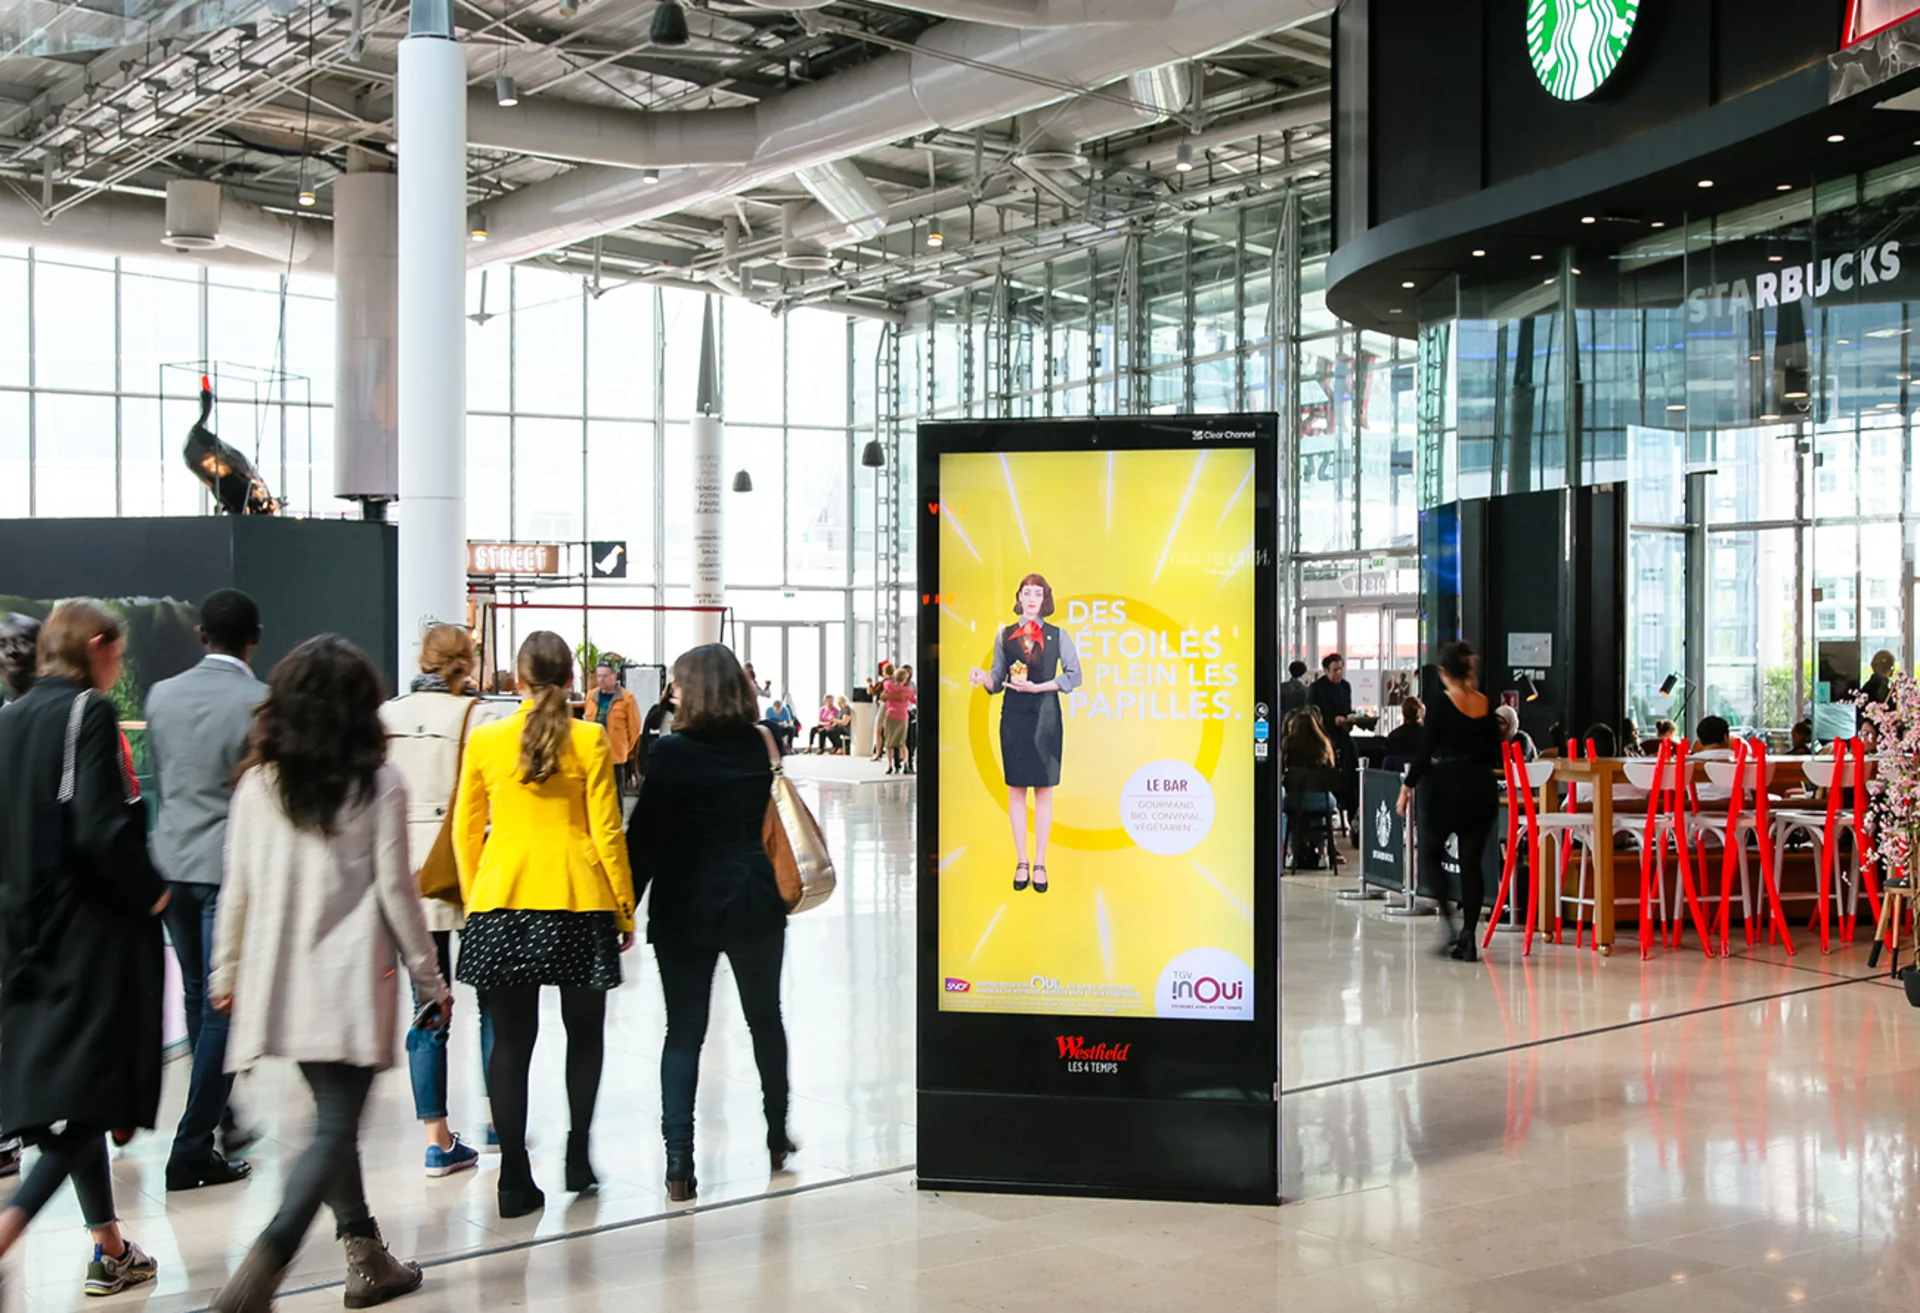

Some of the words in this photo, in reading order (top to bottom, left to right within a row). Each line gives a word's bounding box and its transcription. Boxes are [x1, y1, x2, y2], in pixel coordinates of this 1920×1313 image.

[1688, 240, 1901, 324] STARBUCKS
[1204, 430, 1223, 440] Clear
[1224, 430, 1256, 440] Channel
[475, 545, 547, 572] STREET
[1068, 600, 1127, 625] DES
[1075, 624, 1222, 660] ÉTOILES
[1096, 663, 1176, 687] PLEIN
[1188, 663, 1239, 687] LES
[1068, 691, 1243, 720] PAPILLES.
[1146, 779, 1160, 792] LE
[1163, 779, 1188, 792] BAR
[946, 981, 969, 992] SNCF
[1173, 971, 1193, 980] TGV
[1055, 1035, 1131, 1061] Westfield
[1067, 1061, 1083, 1073] LES
[1084, 1062, 1089, 1073] 4
[1091, 1062, 1118, 1074] TEMPS
